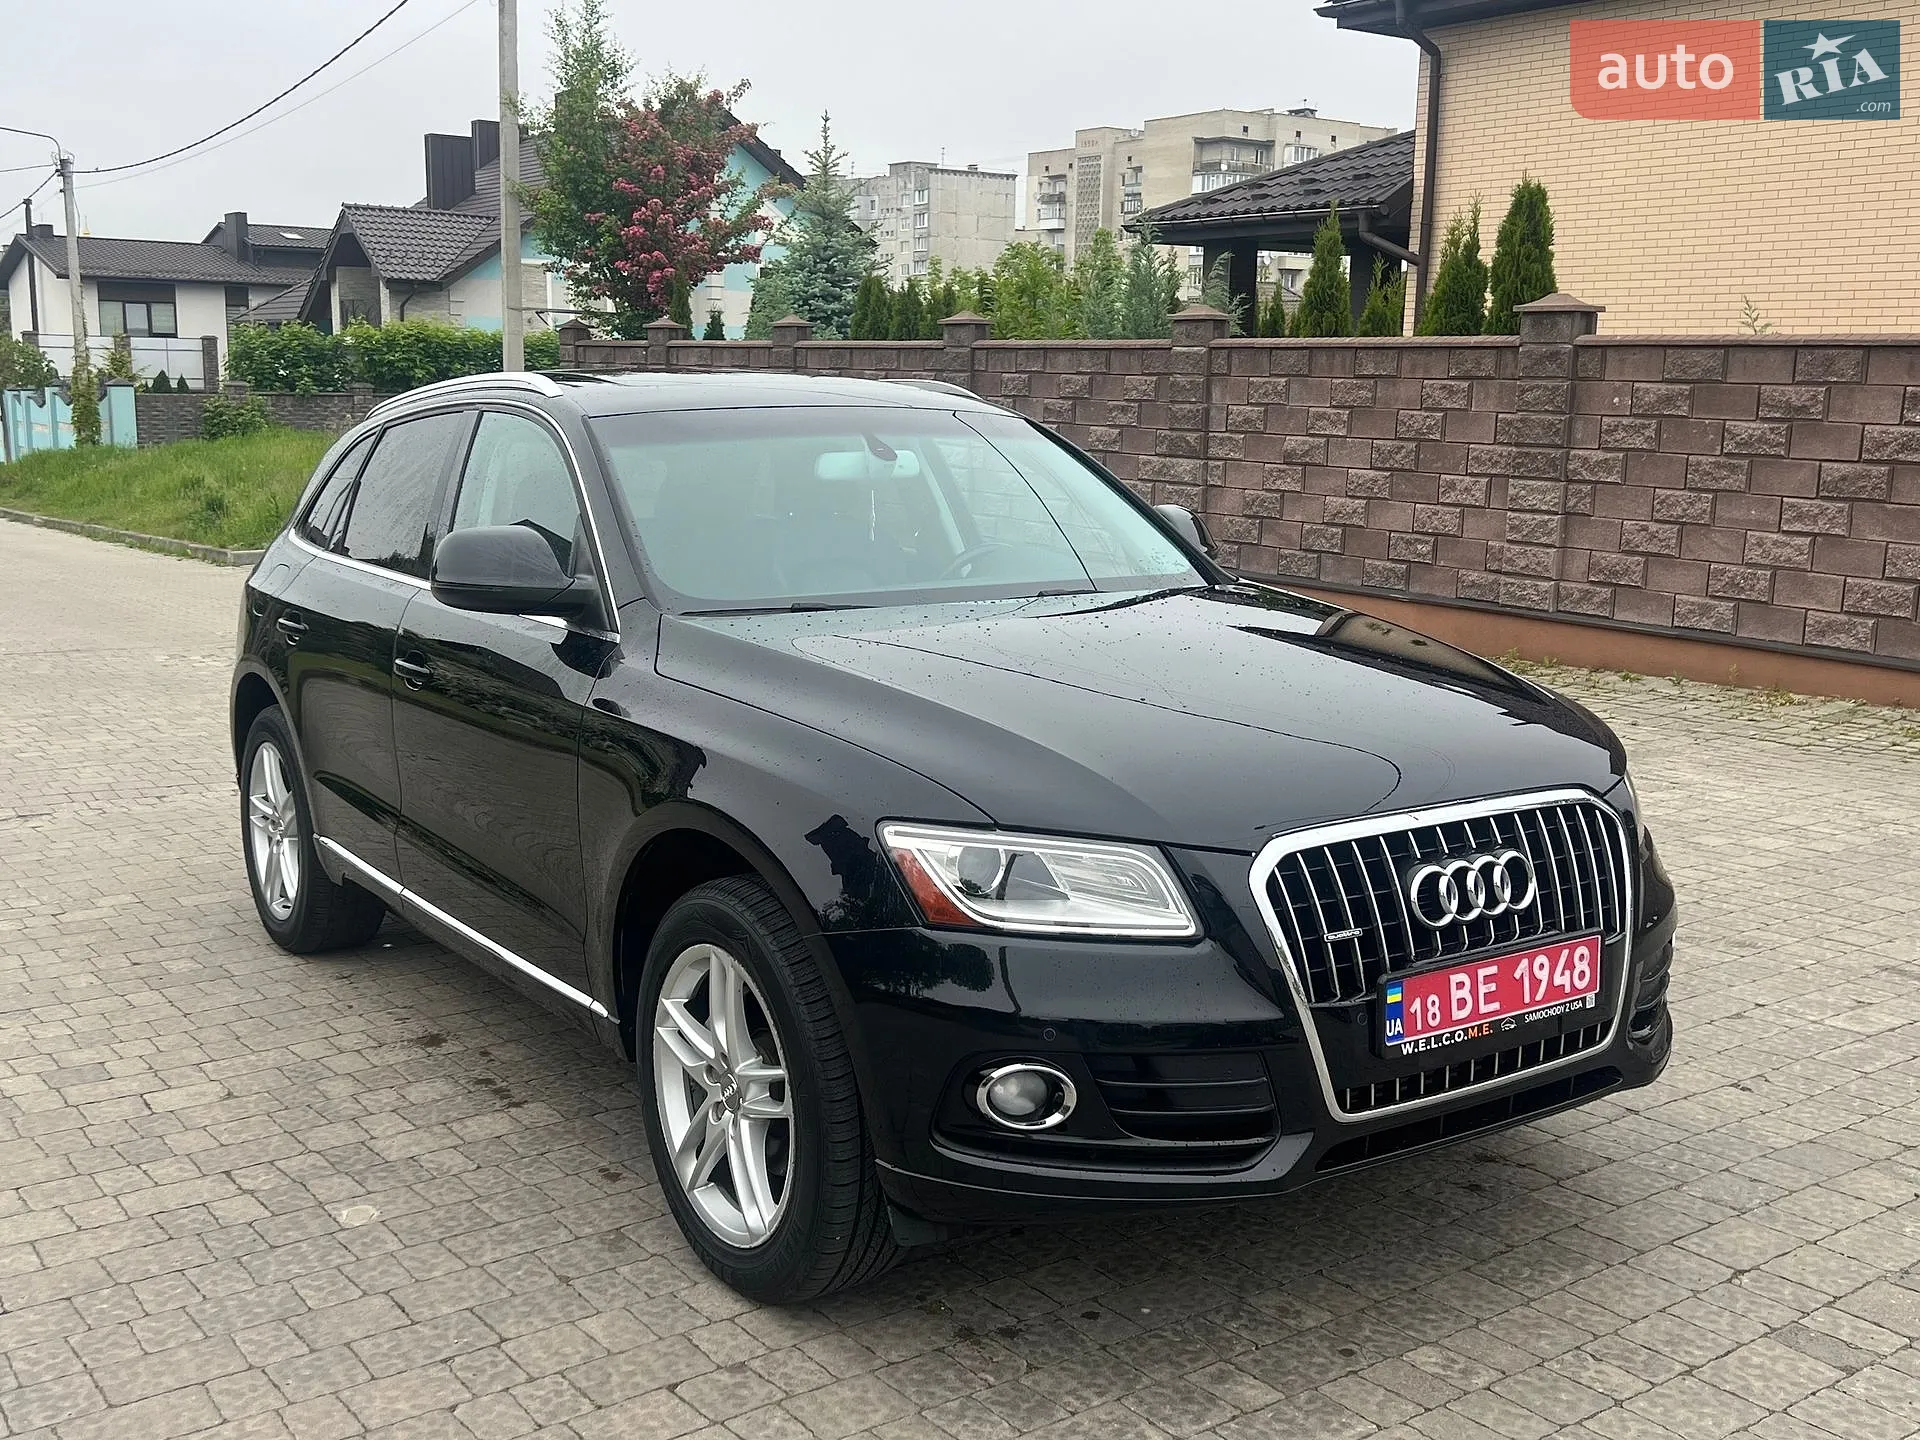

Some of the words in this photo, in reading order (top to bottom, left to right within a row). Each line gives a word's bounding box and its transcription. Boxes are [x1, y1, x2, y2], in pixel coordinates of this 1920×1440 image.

[1409, 994, 1441, 1031] 18
[1449, 965, 1501, 1021] BE
[1513, 945, 1591, 1004] 1948
[1524, 1006, 1565, 1023] SAMOCHODY
[1570, 1000, 1583, 1011] USA
[1386, 1018, 1403, 1036] UA
